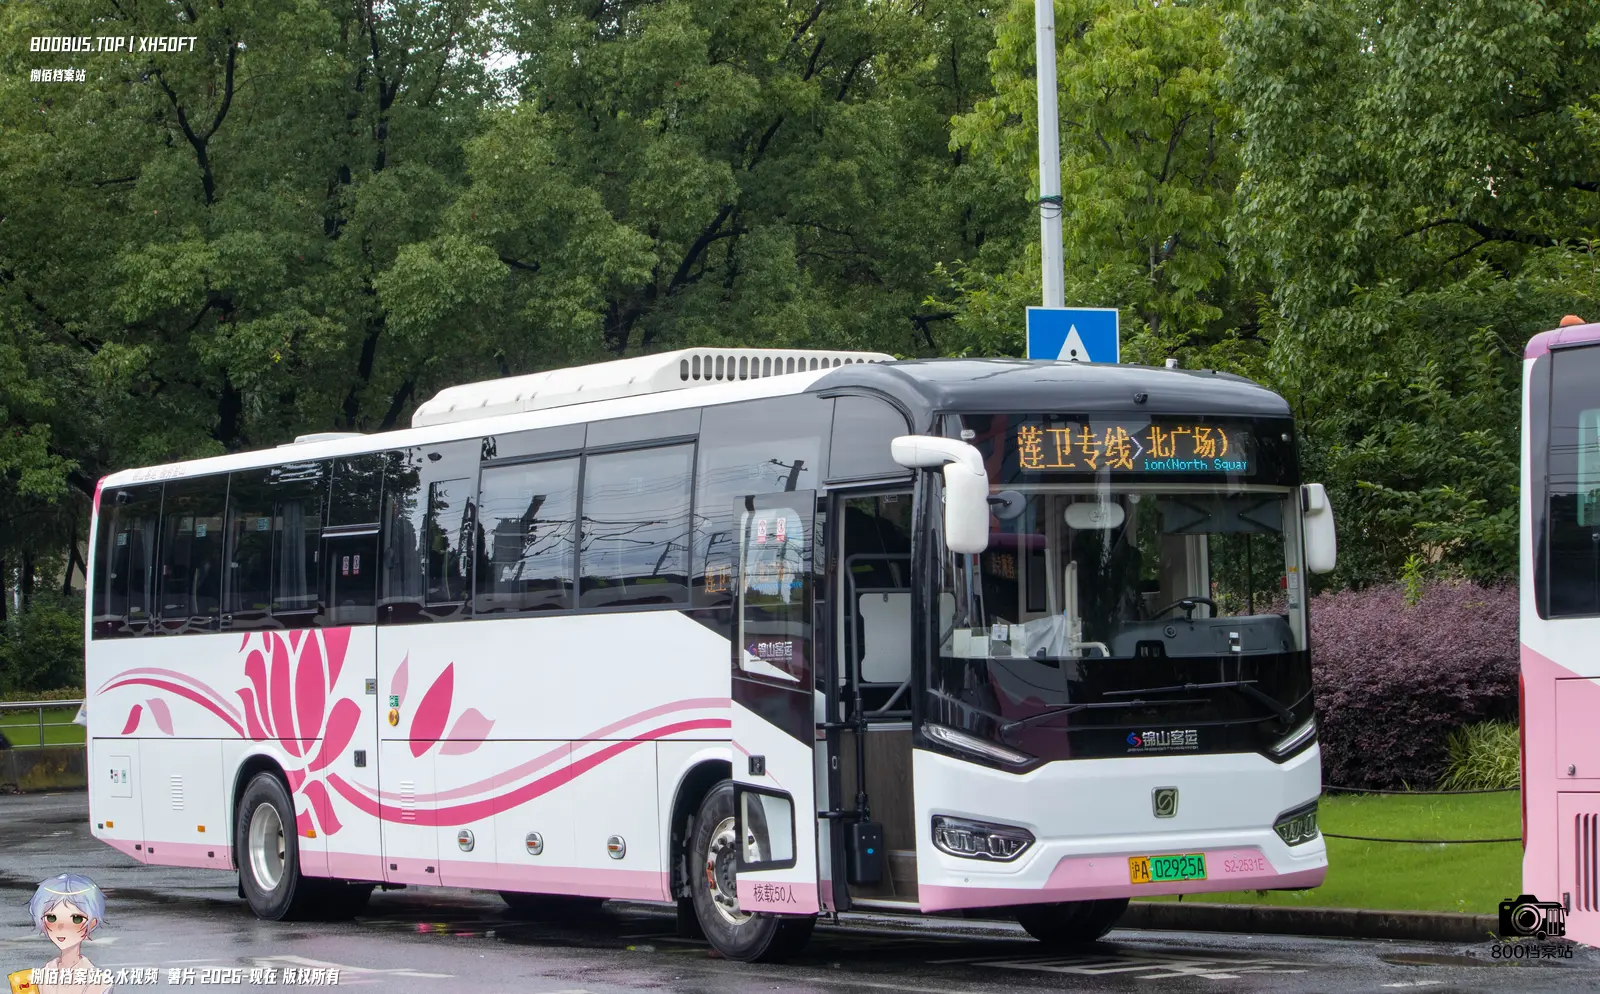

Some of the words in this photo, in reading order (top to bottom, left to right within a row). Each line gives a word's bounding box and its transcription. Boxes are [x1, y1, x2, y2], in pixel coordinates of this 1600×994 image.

[1017, 426, 1133, 470] 莲卫专线
[1142, 729, 1198, 746] 锦山客运
[1155, 857, 1205, 878] 02925A
[1224, 858, 1265, 873] S2-2531E
[754, 882, 797, 903] 核载50人
